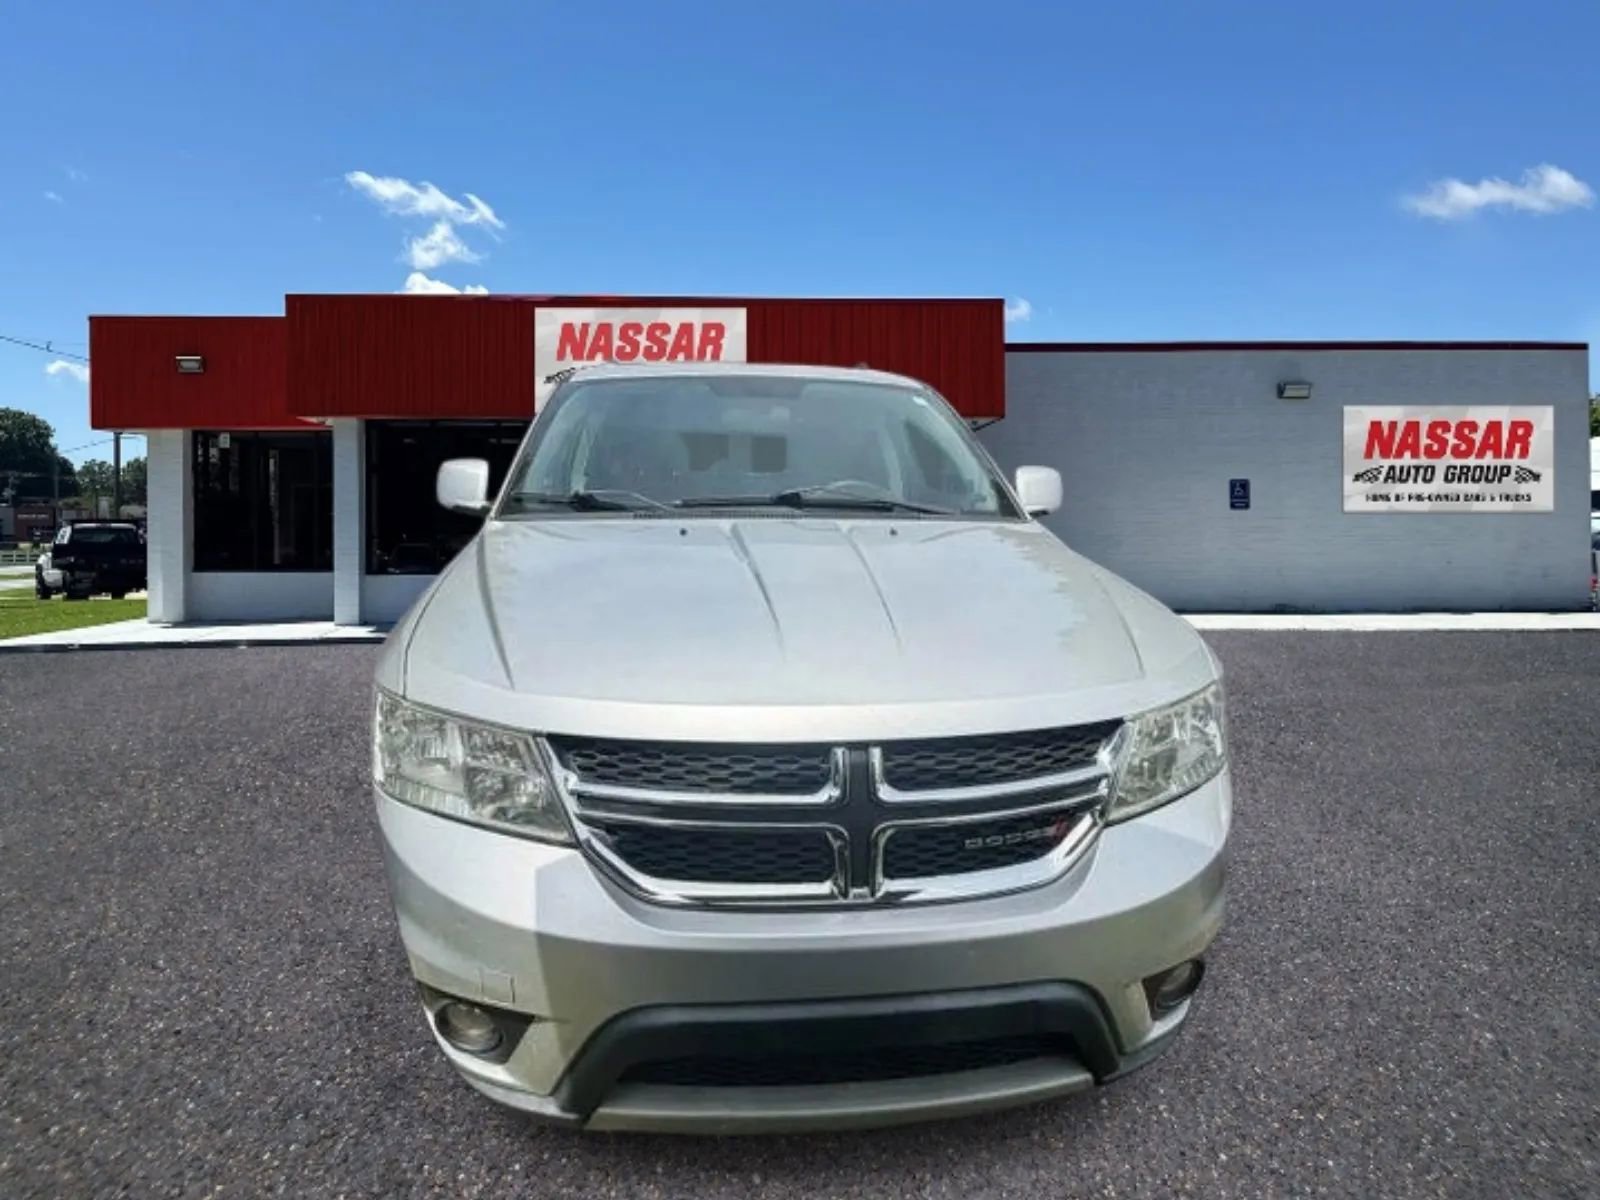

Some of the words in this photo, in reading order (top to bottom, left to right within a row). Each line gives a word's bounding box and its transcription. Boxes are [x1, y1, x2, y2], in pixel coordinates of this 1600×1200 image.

[556, 322, 726, 362] NASSAR
[1363, 420, 1534, 460] NASSAR
[1383, 465, 1436, 484] AUTO
[1443, 465, 1512, 484] GROUP
